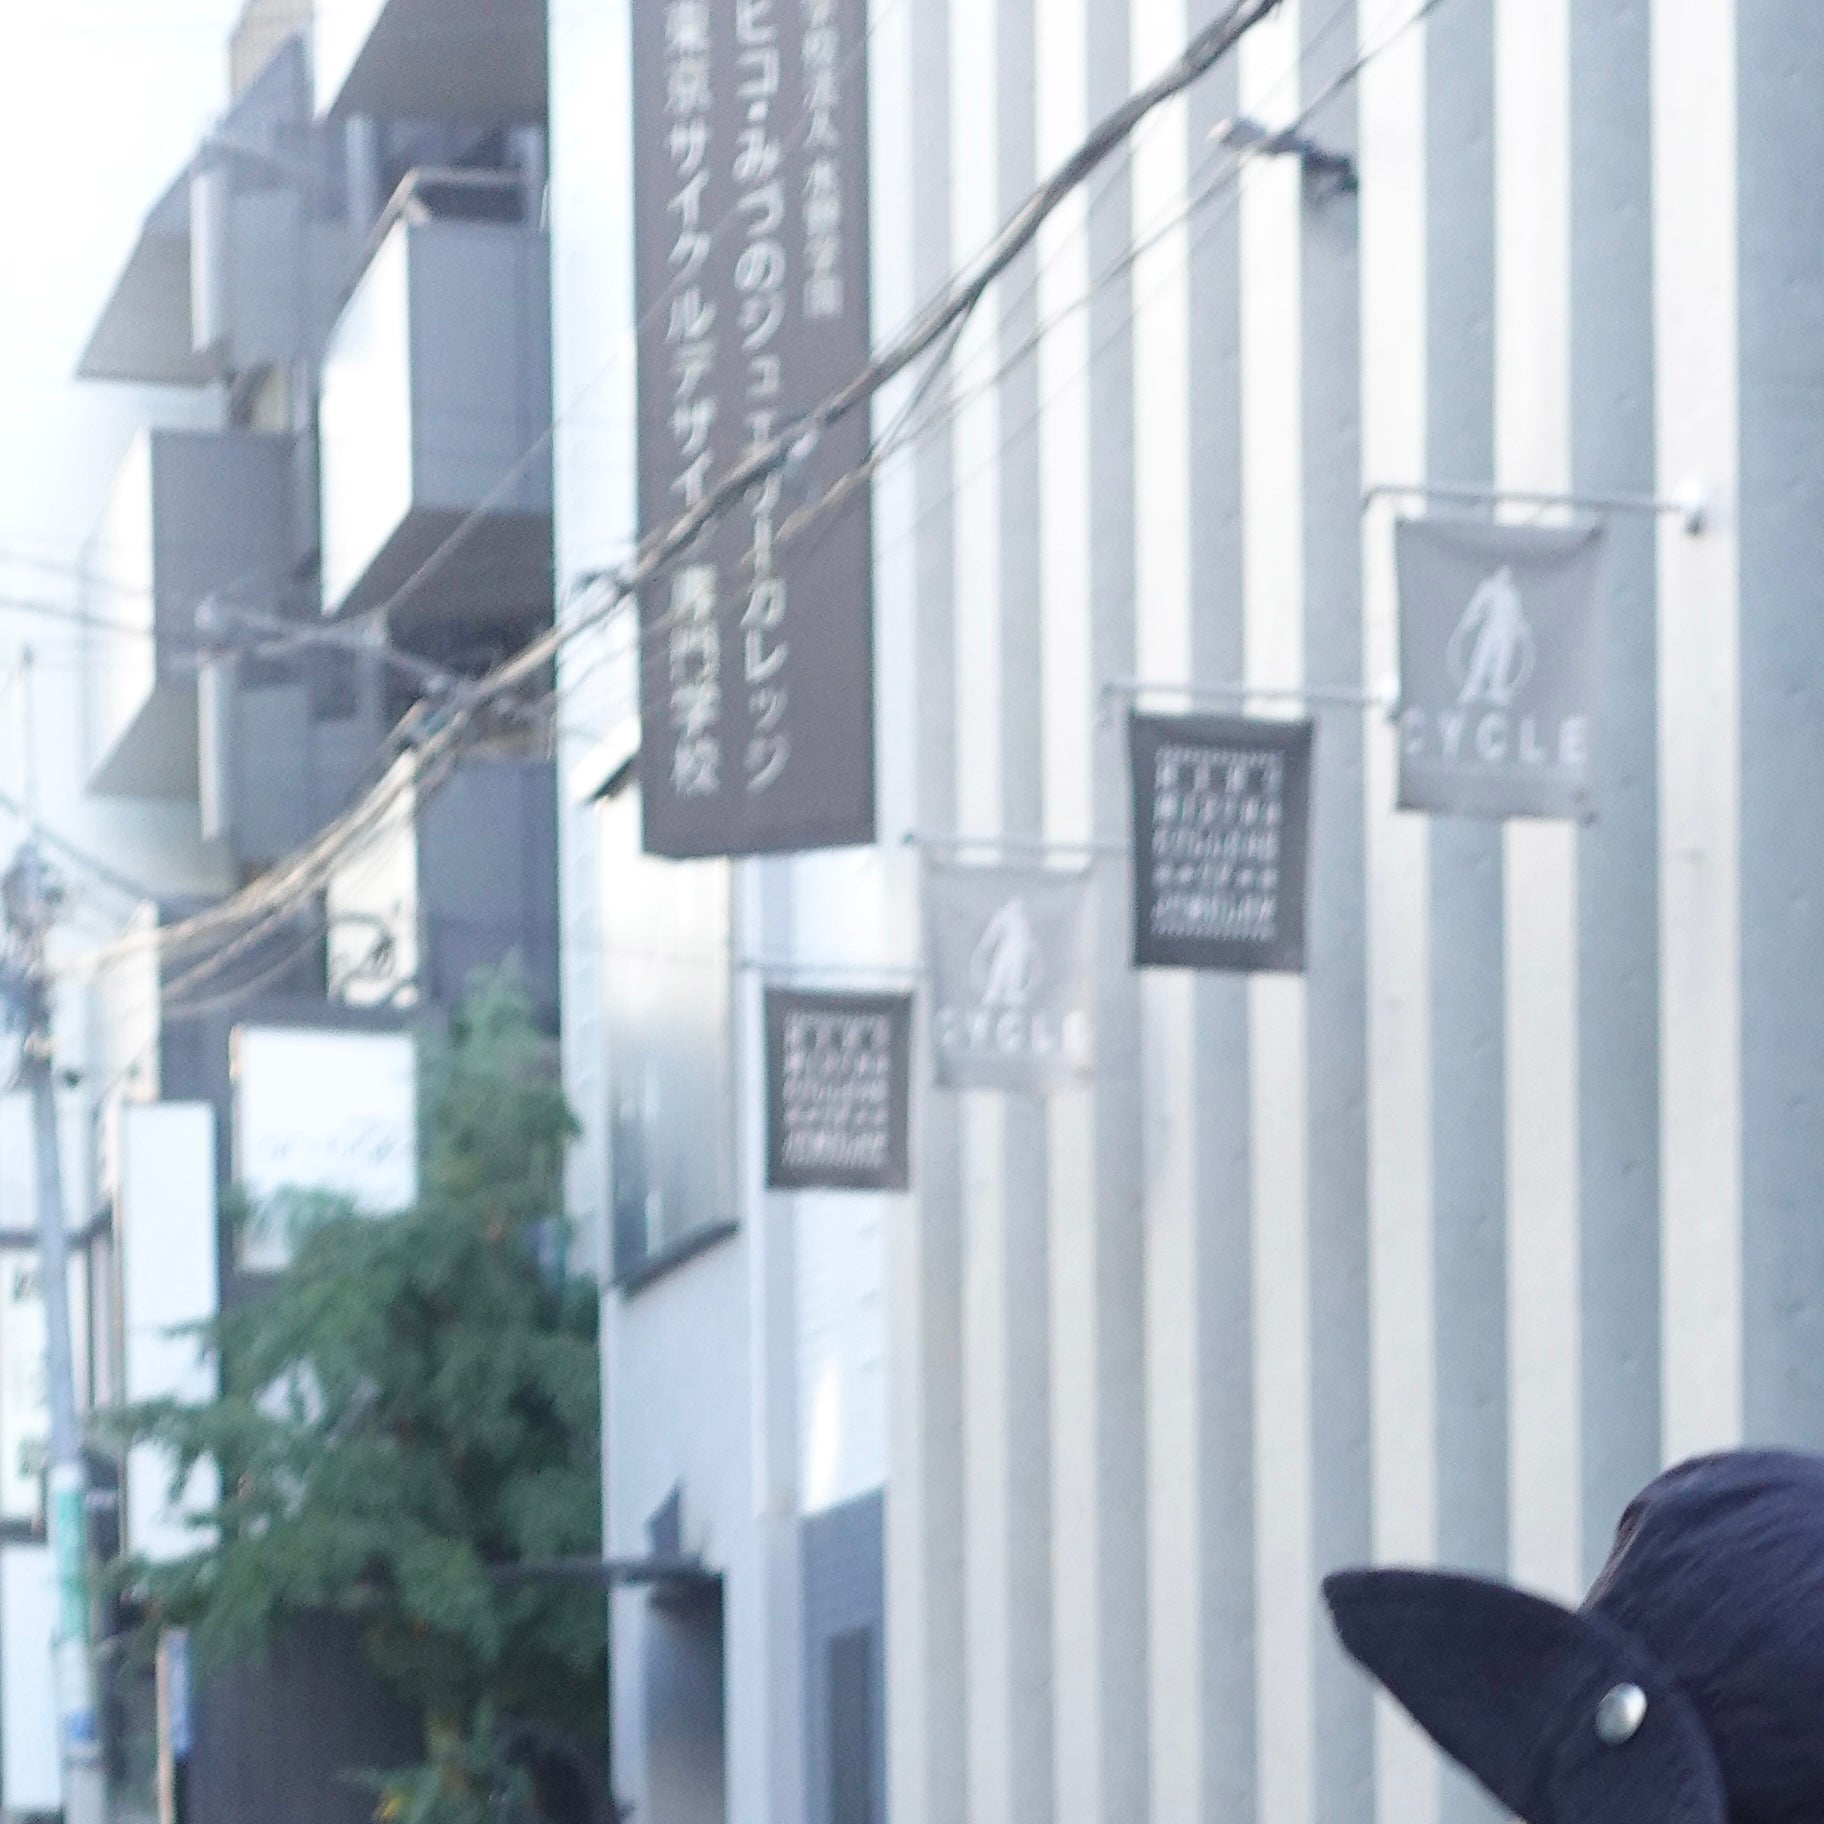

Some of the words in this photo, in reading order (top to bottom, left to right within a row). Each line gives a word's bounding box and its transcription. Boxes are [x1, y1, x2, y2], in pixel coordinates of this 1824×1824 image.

[664, 0, 719, 555] 東京サイクルデザイ
[1401, 706, 1590, 764] CYCLE
